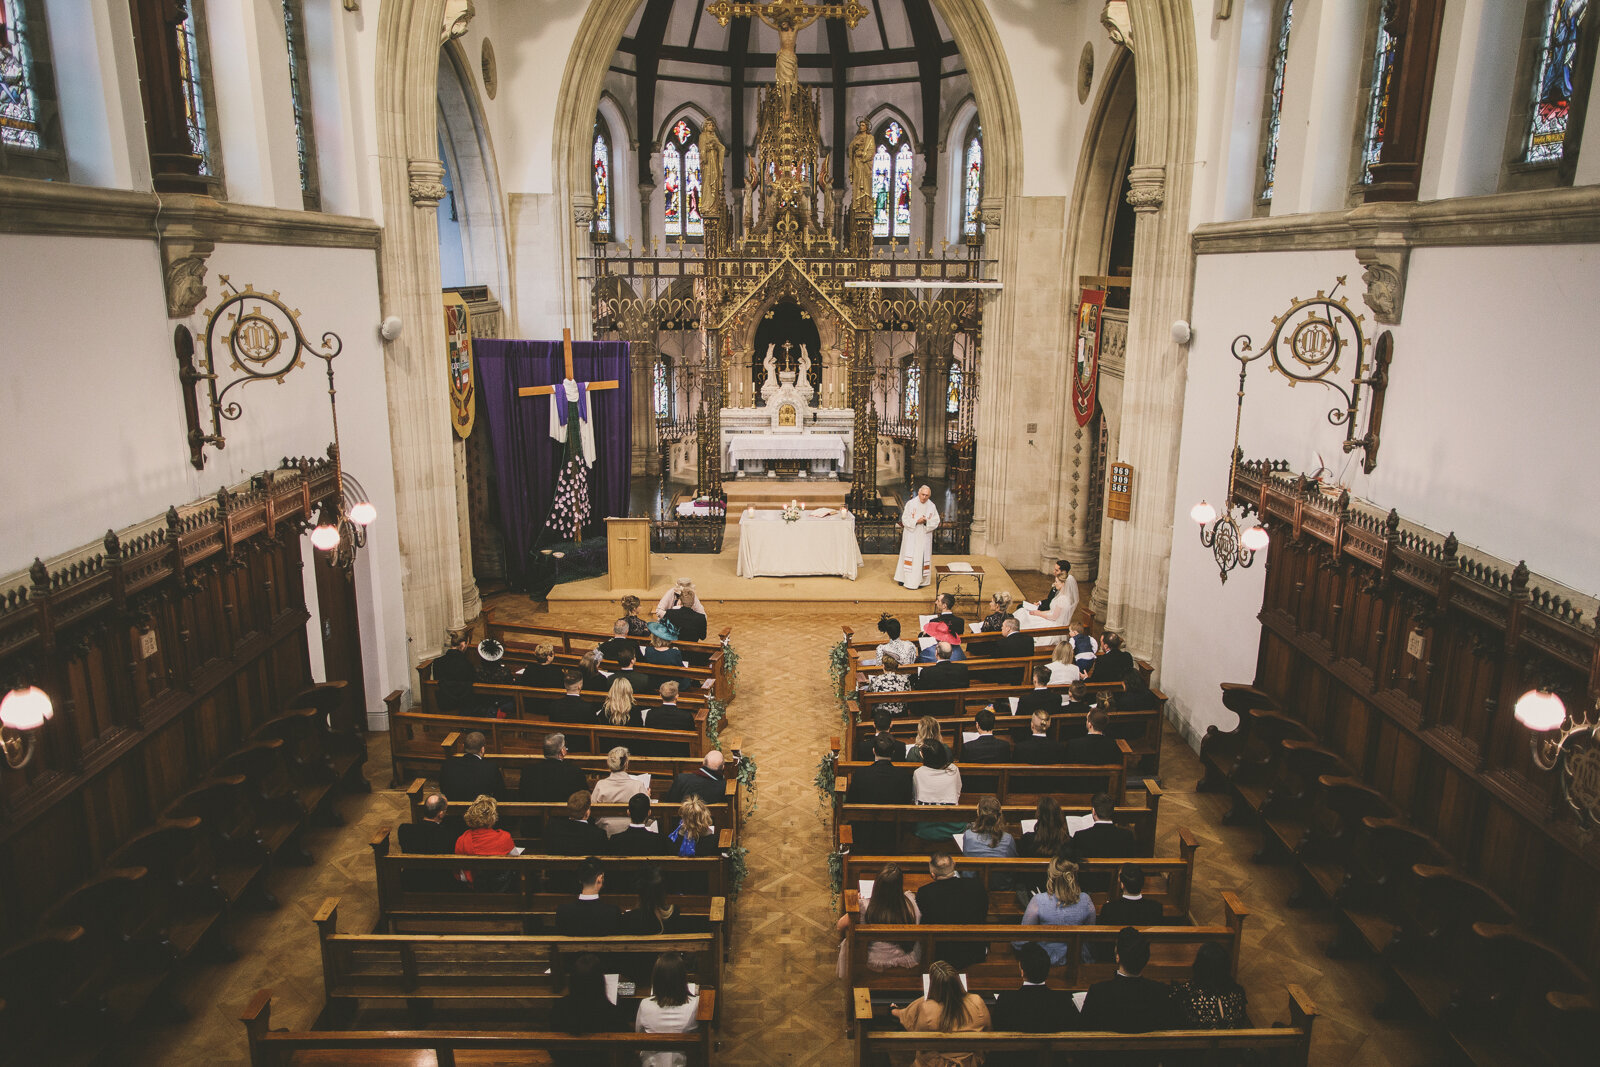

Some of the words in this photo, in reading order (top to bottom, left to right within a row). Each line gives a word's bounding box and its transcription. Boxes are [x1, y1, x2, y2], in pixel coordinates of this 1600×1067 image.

[1113, 466, 1129, 476] 969
[1112, 475, 1129, 484] 909
[1111, 483, 1127, 493] 565
